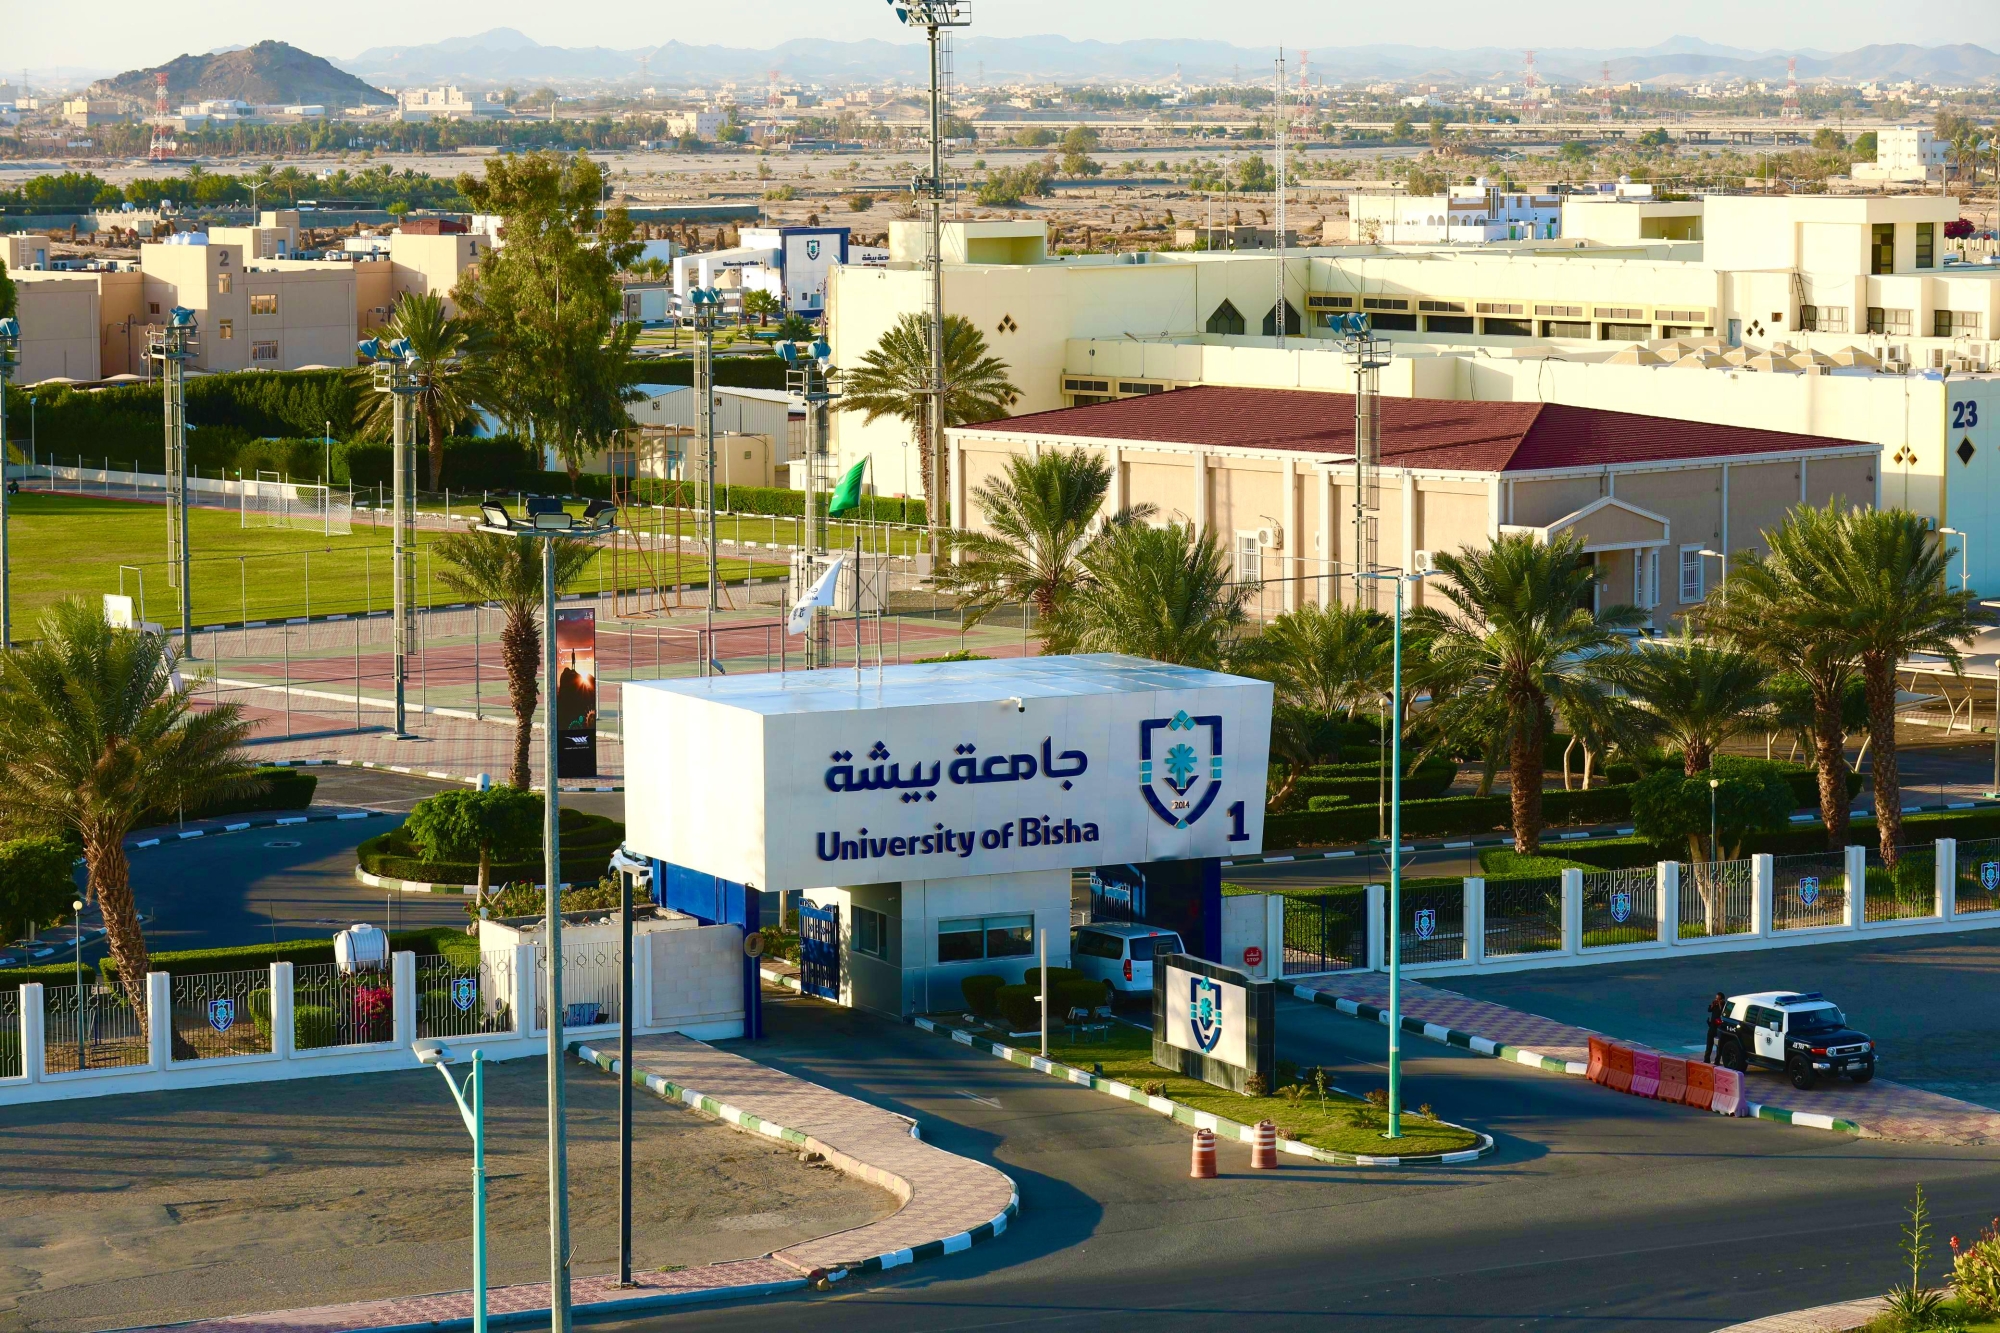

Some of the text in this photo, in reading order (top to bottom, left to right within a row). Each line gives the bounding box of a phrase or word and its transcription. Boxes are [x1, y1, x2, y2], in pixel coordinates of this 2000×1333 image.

[219, 250, 230, 267] 2
[469, 240, 478, 256] 1
[1952, 400, 1978, 429] 23
[824, 735, 1089, 803] جامعة بيشة
[1172, 801, 1190, 810] 2014
[1227, 800, 1250, 841] 1
[816, 814, 1100, 862] University of Bisha
